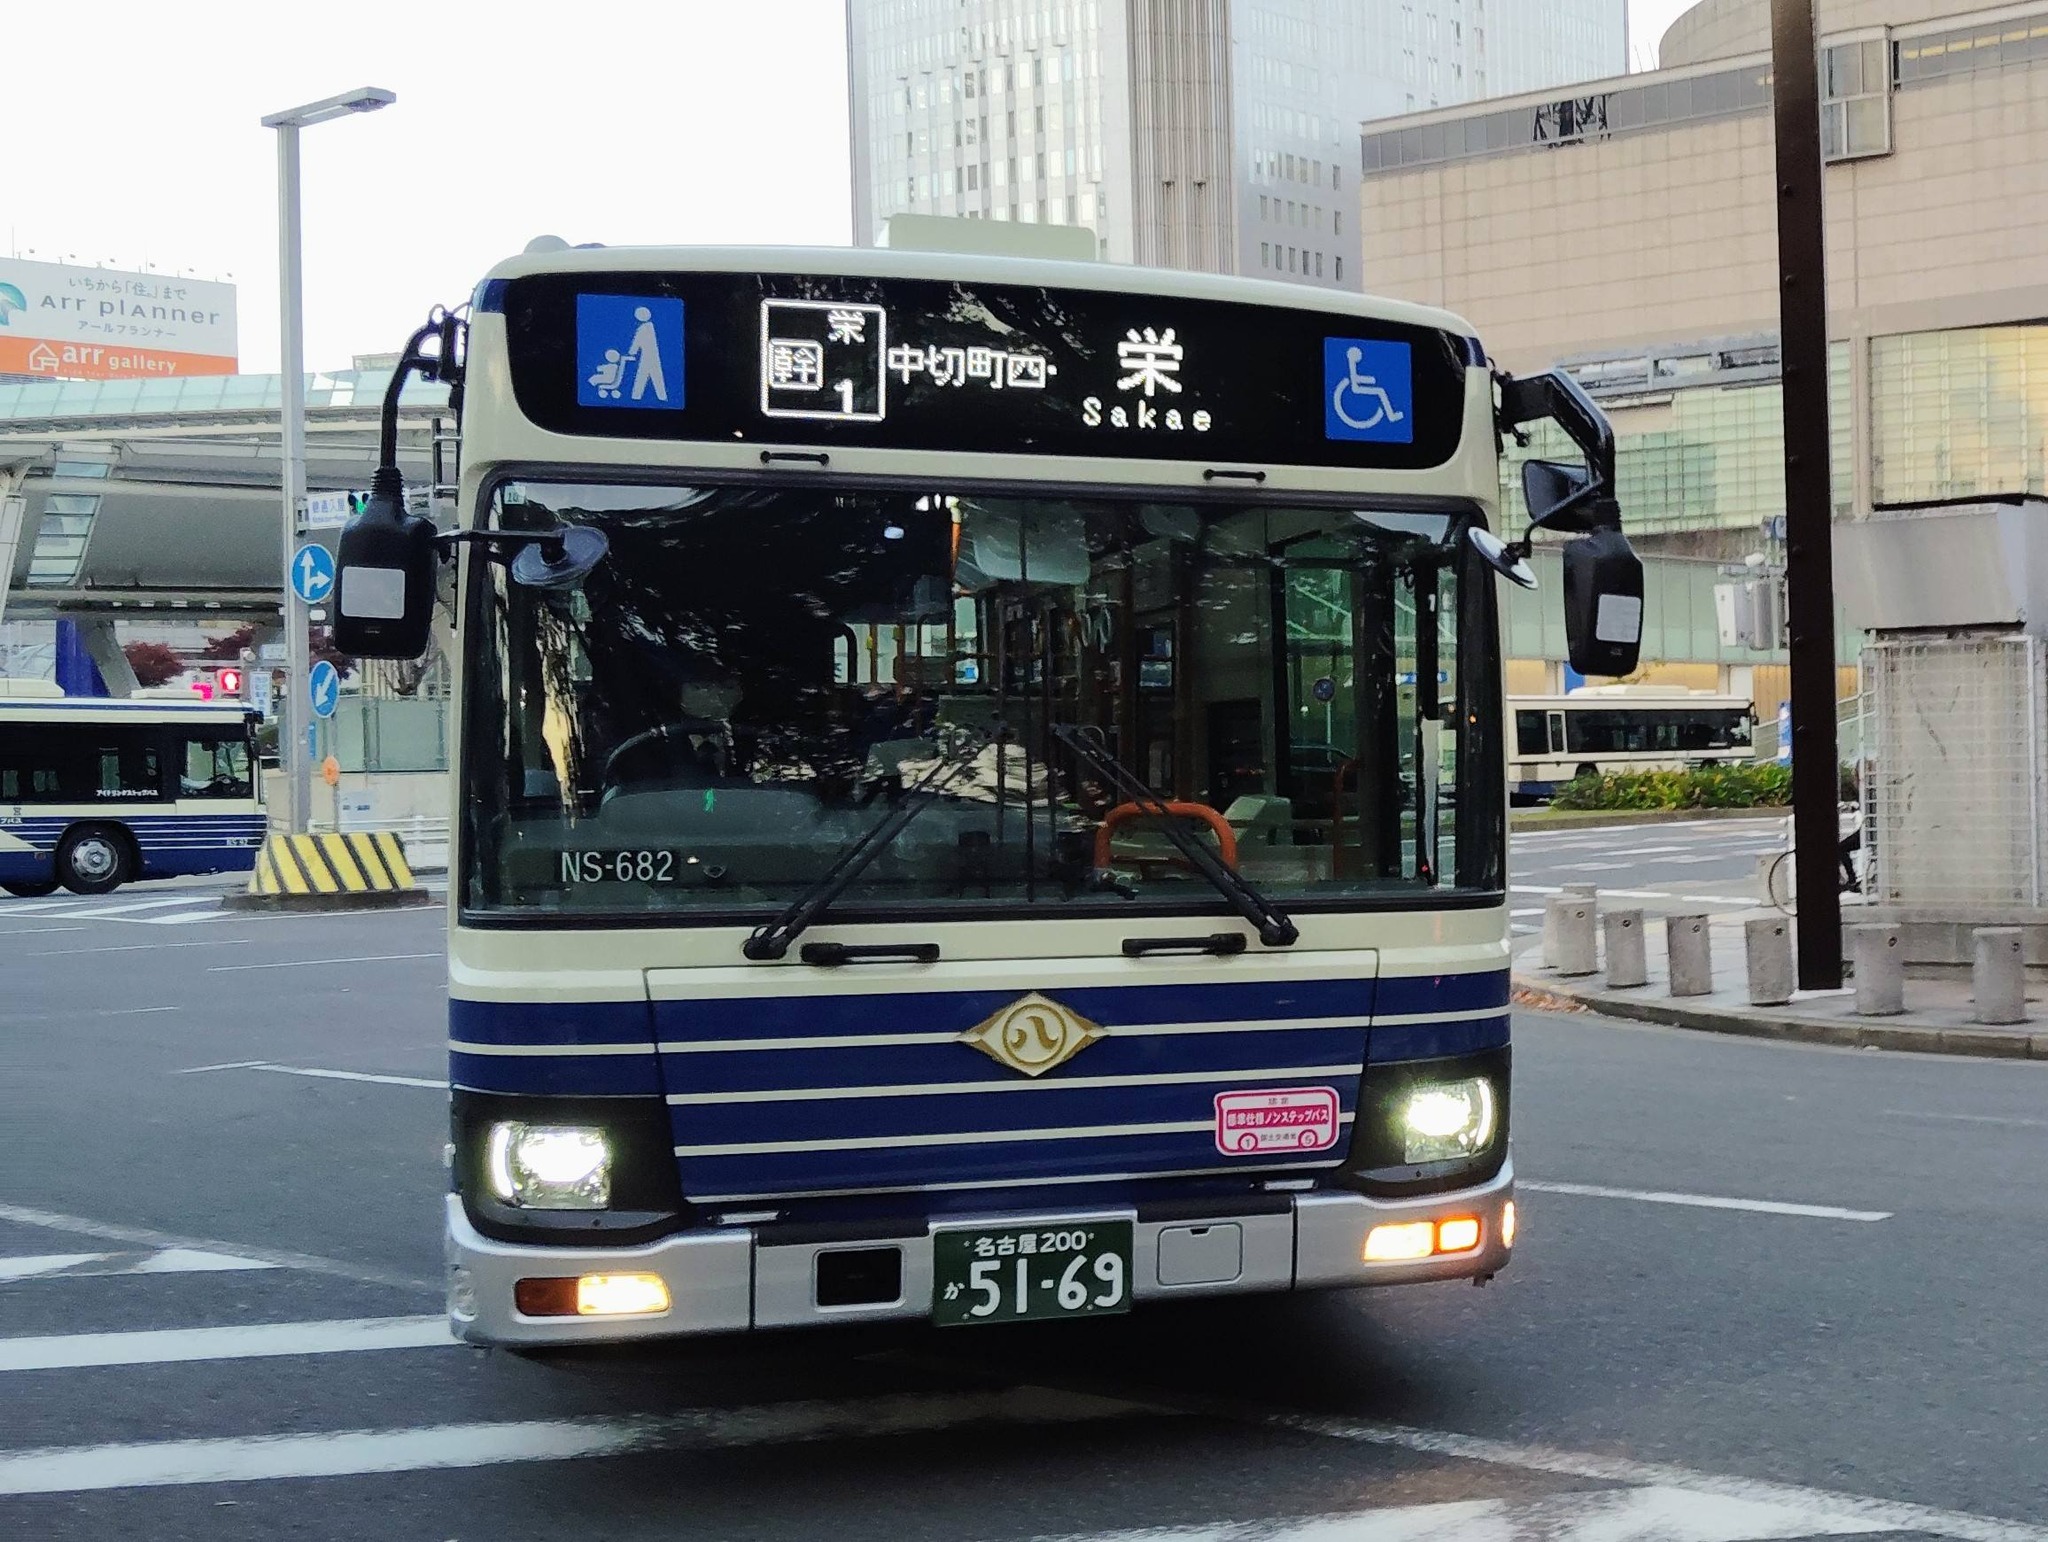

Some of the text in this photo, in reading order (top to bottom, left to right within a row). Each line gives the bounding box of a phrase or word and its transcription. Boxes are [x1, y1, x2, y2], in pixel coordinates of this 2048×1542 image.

[40, 294, 87, 311] Arr
[827, 310, 866, 345] 栄
[62, 344, 105, 366] arr
[108, 355, 177, 375] gallery
[1116, 326, 1184, 397] 栄
[833, 378, 854, 414] 1
[1082, 396, 1212, 432] Sakae
[561, 850, 673, 883] NS-682
[970, 1252, 1124, 1317] 51-69
